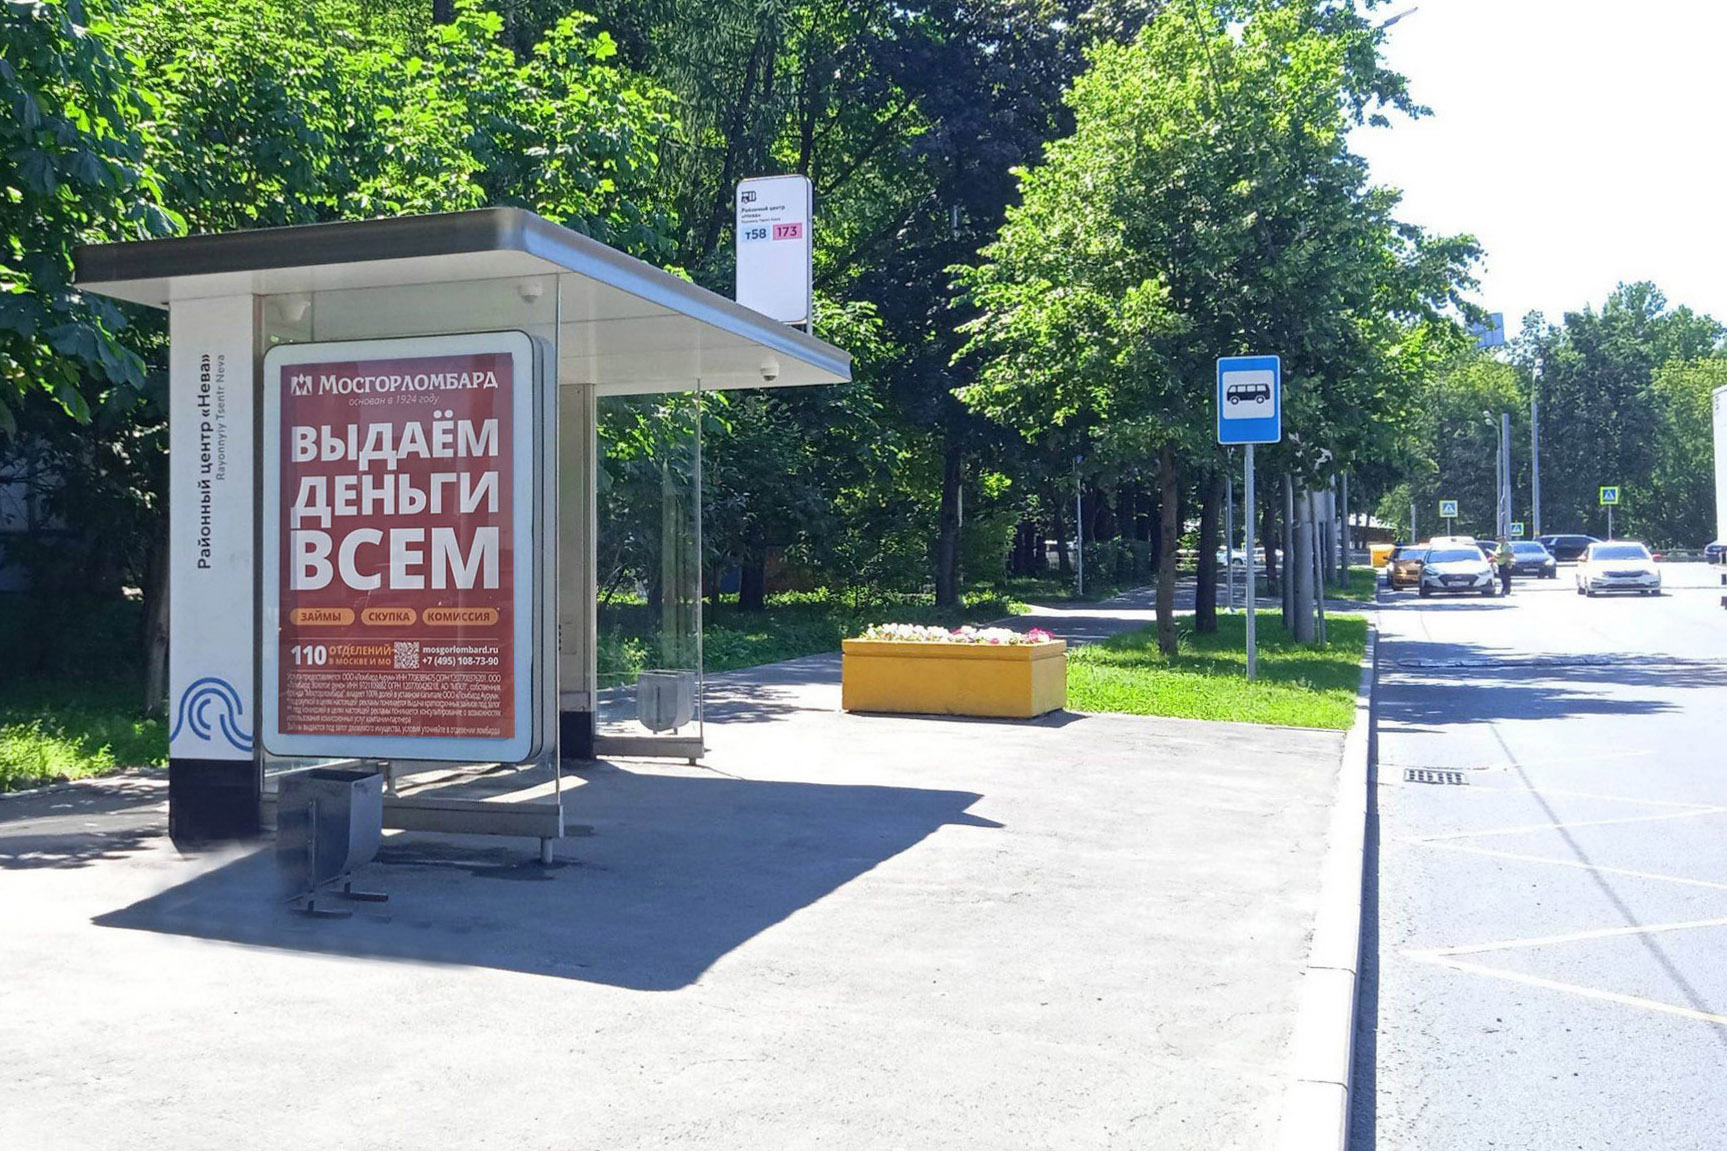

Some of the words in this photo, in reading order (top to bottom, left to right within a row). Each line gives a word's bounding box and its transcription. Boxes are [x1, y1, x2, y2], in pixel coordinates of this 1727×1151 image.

[777, 226, 797, 237] 173
[215, 354, 225, 383] Neva
[197, 354, 211, 418] «Нева»
[396, 395, 417, 405] 1924
[418, 393, 440, 406] году
[291, 410, 499, 471] ВЫДАЁМ
[200, 422, 213, 474] центр
[290, 471, 499, 528] ДЕНЬГИ
[197, 479, 211, 569] Районный
[290, 526, 499, 591] ВСЕМ
[300, 609, 341, 621] ЗАЙМЫ
[368, 611, 410, 621] СКУПКА
[427, 611, 490, 621] КОМИССИЯ
[290, 645, 327, 665] 110
[329, 644, 392, 657] ОТДЕЛЕНИЙ
[422, 645, 499, 656] mosgorlombard.ru
[335, 657, 368, 665] МОСКВЕ
[369, 657, 376, 665] И
[377, 657, 392, 665] МО
[422, 656, 432, 665] +7
[433, 656, 456, 667] (495)
[458, 656, 499, 665] 108-73-90
